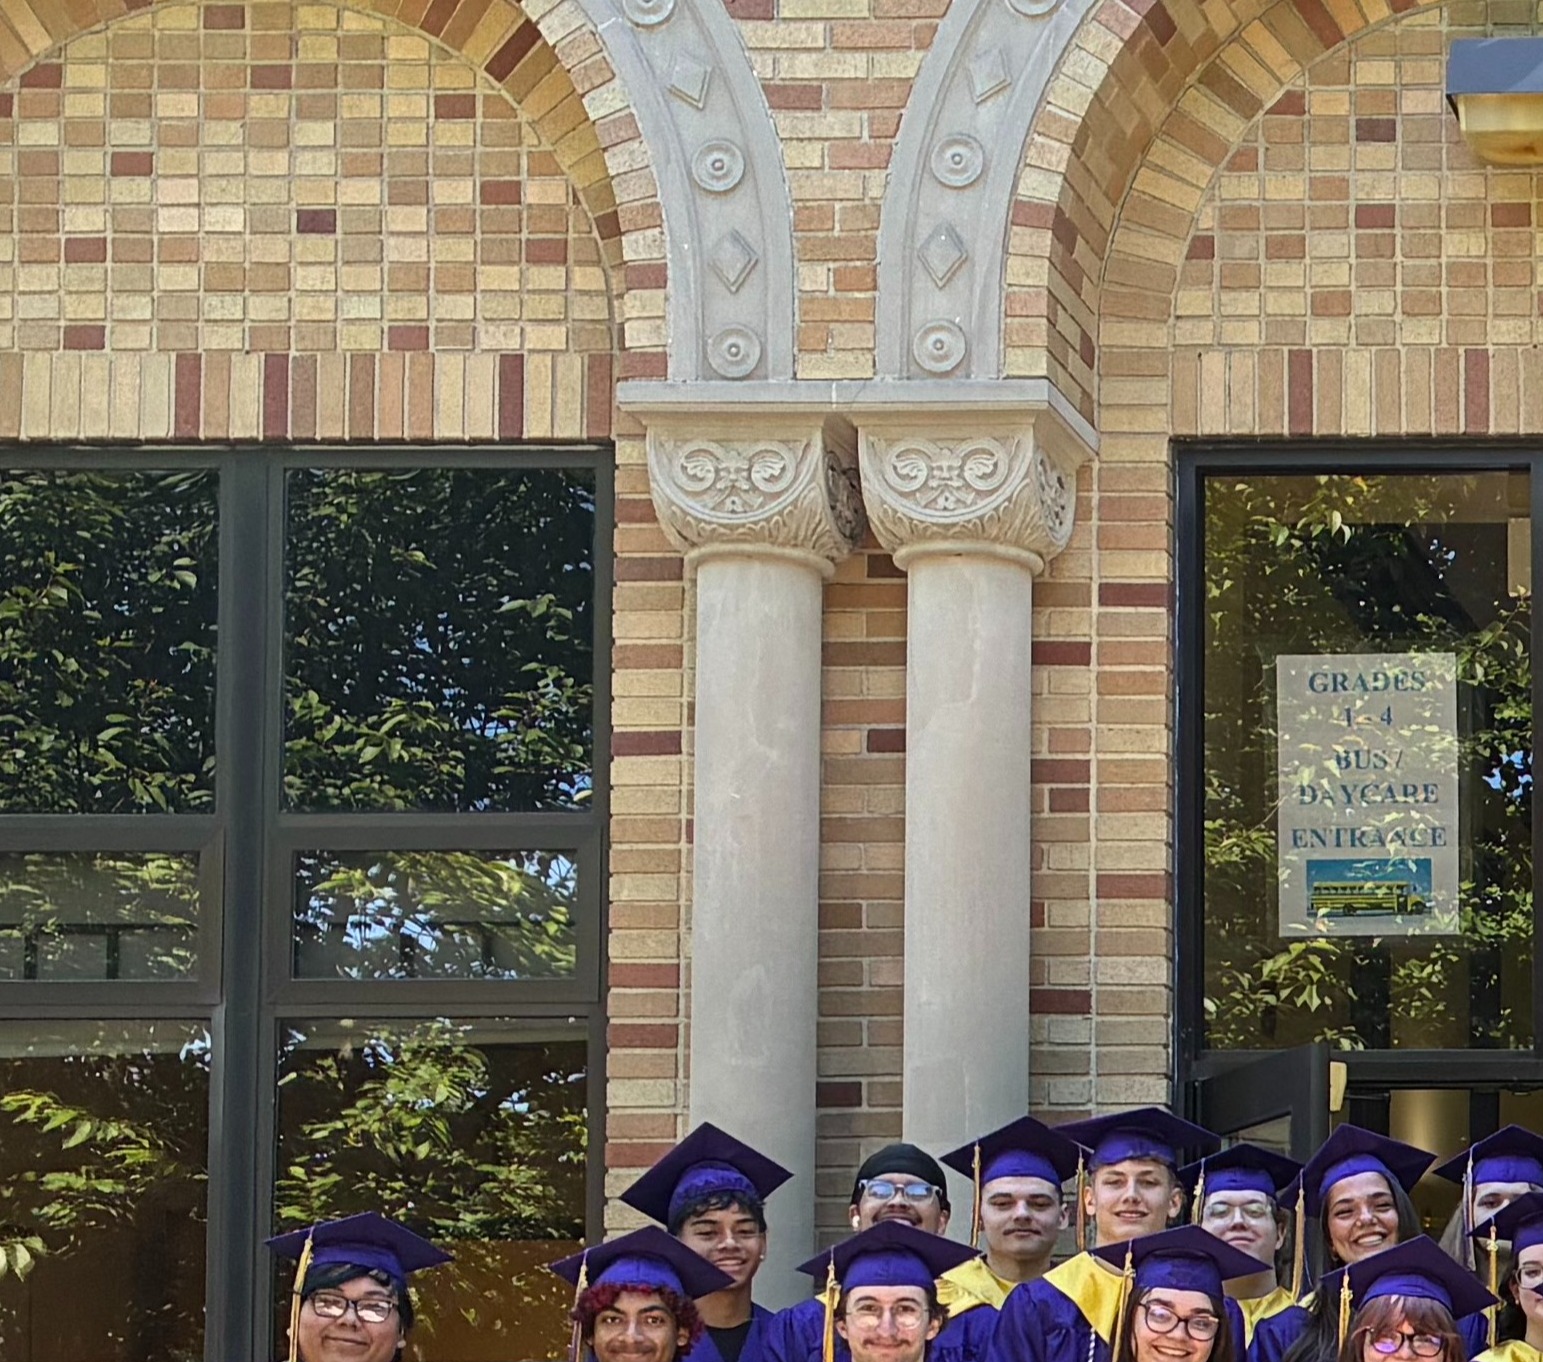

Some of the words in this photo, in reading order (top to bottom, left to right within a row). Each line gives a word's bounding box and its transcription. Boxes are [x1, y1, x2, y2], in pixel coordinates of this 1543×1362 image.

[1308, 671, 1426, 694] GRADES
[1344, 705, 1352, 728] 1
[1380, 705, 1393, 726] 4
[1335, 748, 1389, 770] BUS
[1299, 783, 1440, 806] DAYCARE
